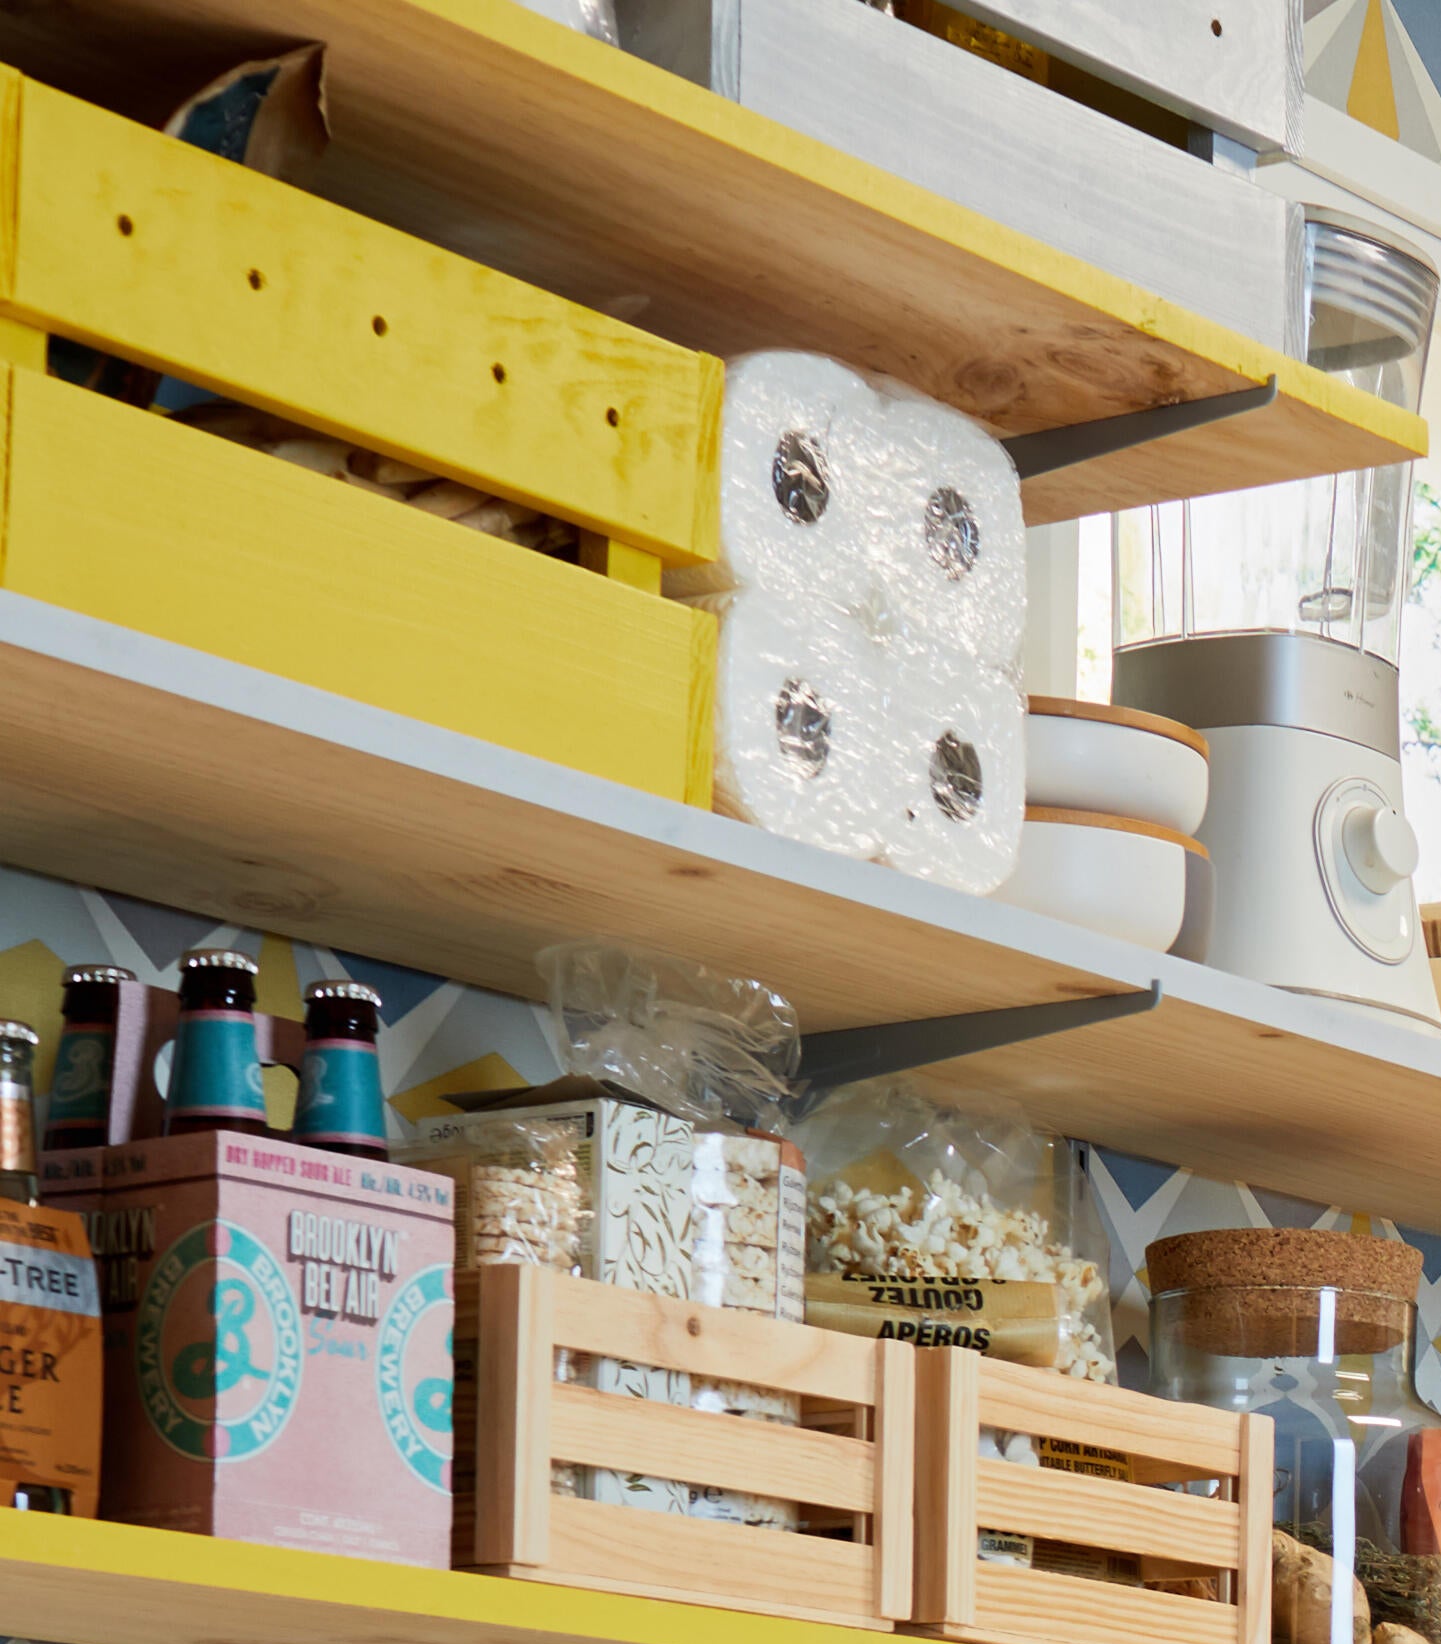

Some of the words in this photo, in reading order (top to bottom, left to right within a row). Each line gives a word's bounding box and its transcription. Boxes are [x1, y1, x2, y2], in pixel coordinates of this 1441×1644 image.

[225, 1144, 250, 1165] DRY
[253, 1148, 298, 1177] HOPPED
[300, 1160, 330, 1183] SOUR
[332, 1166, 353, 1188] ALE
[290, 1209, 400, 1276] BROOKLYN
[304, 1262, 342, 1313] BEL
[344, 1270, 382, 1318] AIR
[249, 1254, 298, 1444] BROOKLYN
[378, 1284, 427, 1459] BREWERY
